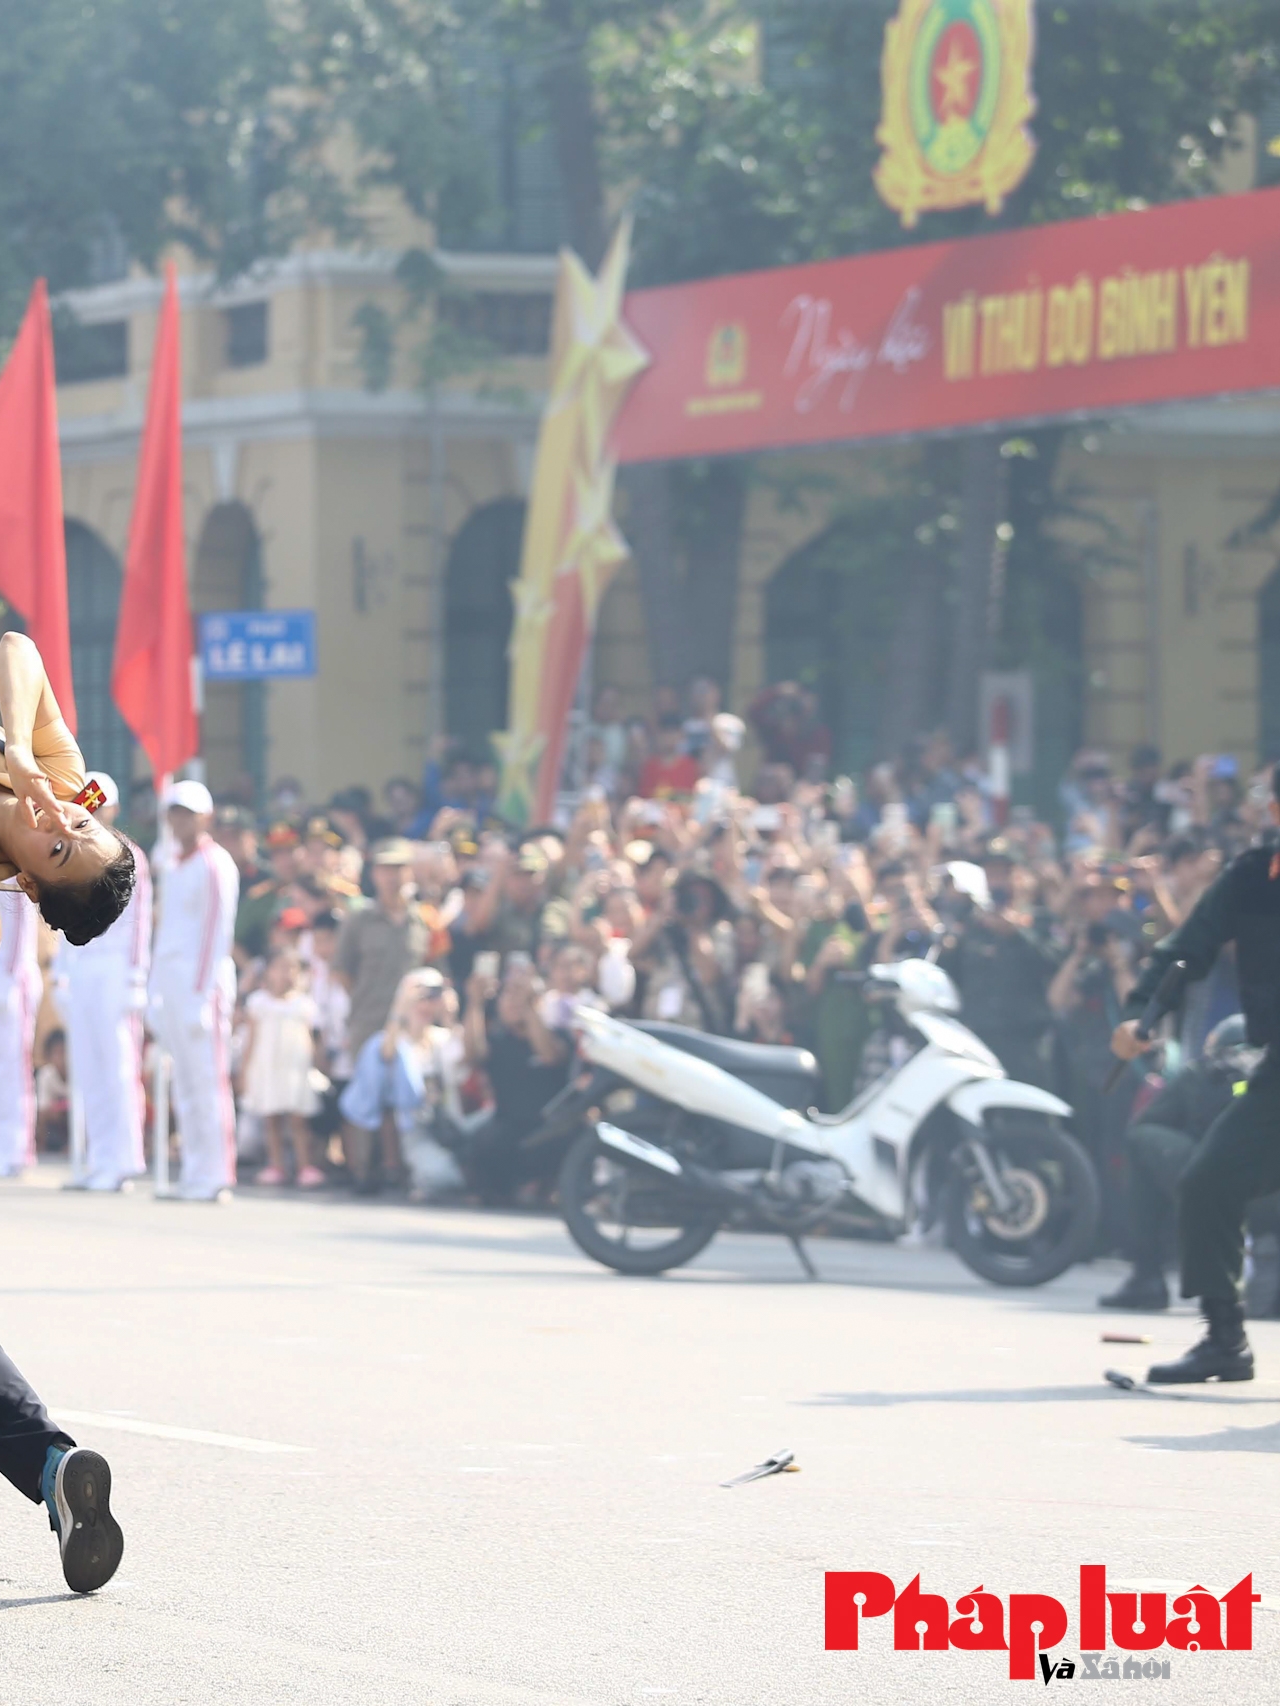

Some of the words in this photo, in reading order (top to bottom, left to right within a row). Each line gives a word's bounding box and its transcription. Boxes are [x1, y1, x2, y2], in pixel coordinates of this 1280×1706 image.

[980, 271, 1042, 376] THỦ
[1098, 264, 1177, 359] BÌNH
[1184, 249, 1251, 346] YÊN
